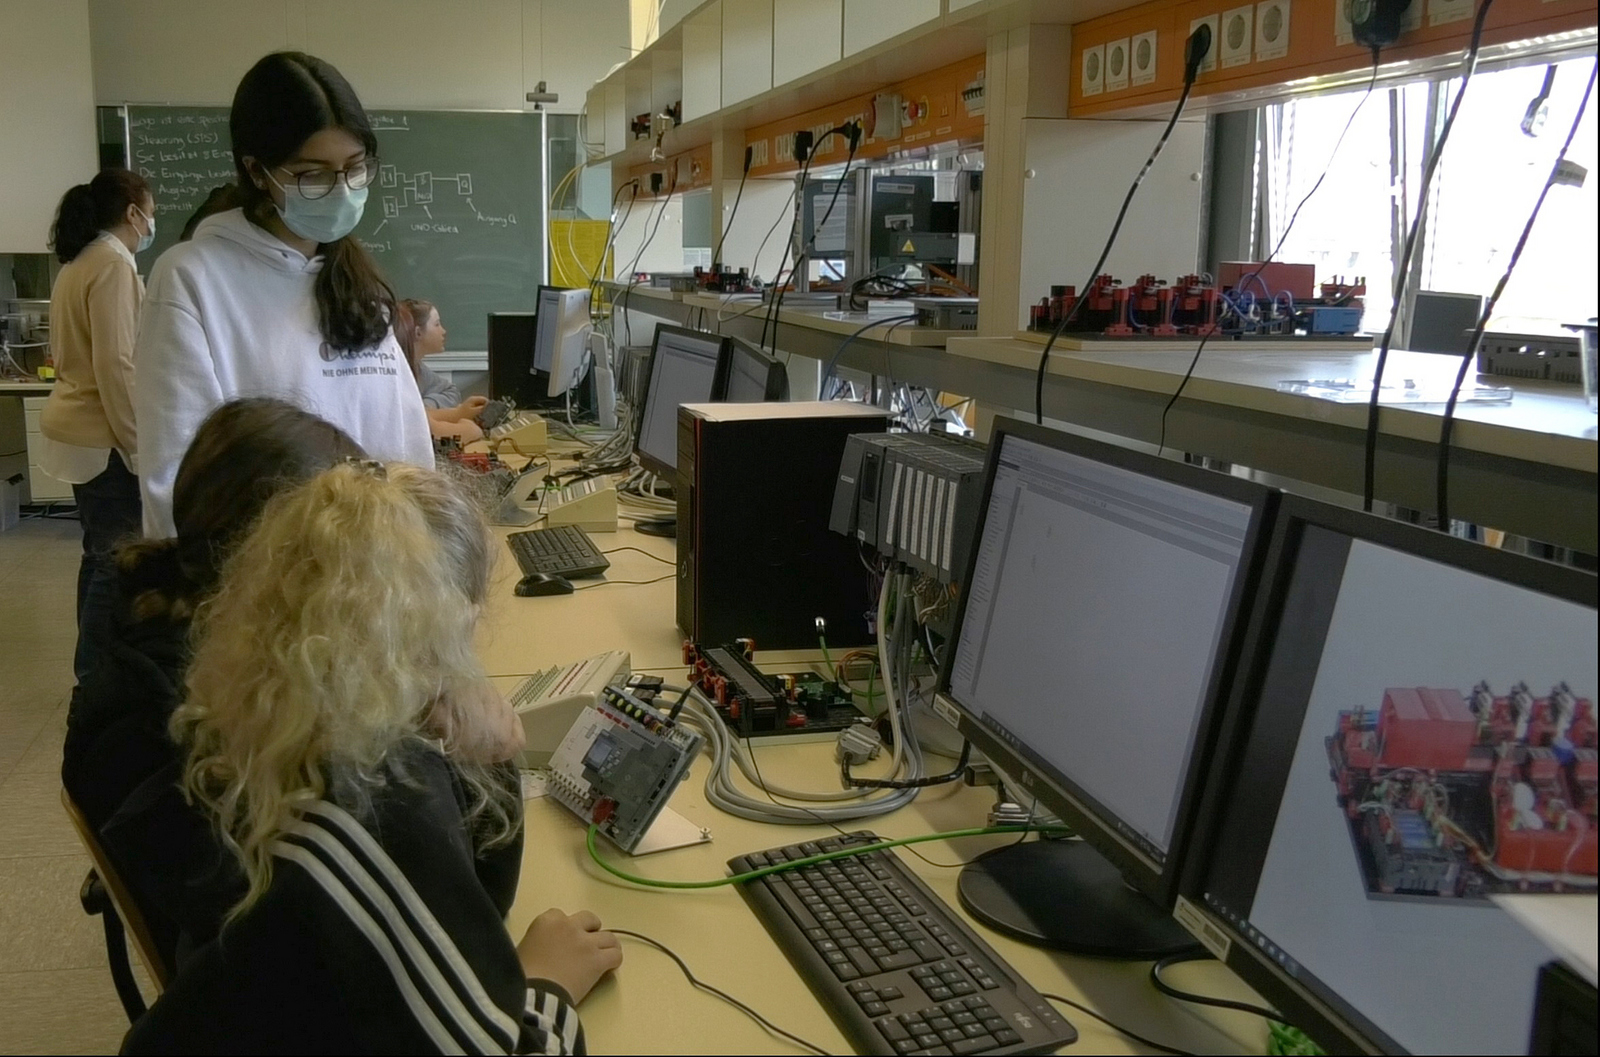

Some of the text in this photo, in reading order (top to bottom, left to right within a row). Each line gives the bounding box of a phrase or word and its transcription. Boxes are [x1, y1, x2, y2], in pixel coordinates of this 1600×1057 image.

[322, 368, 335, 378] NIE
[336, 366, 360, 377] OHNE
[360, 366, 378, 375] MEIN
